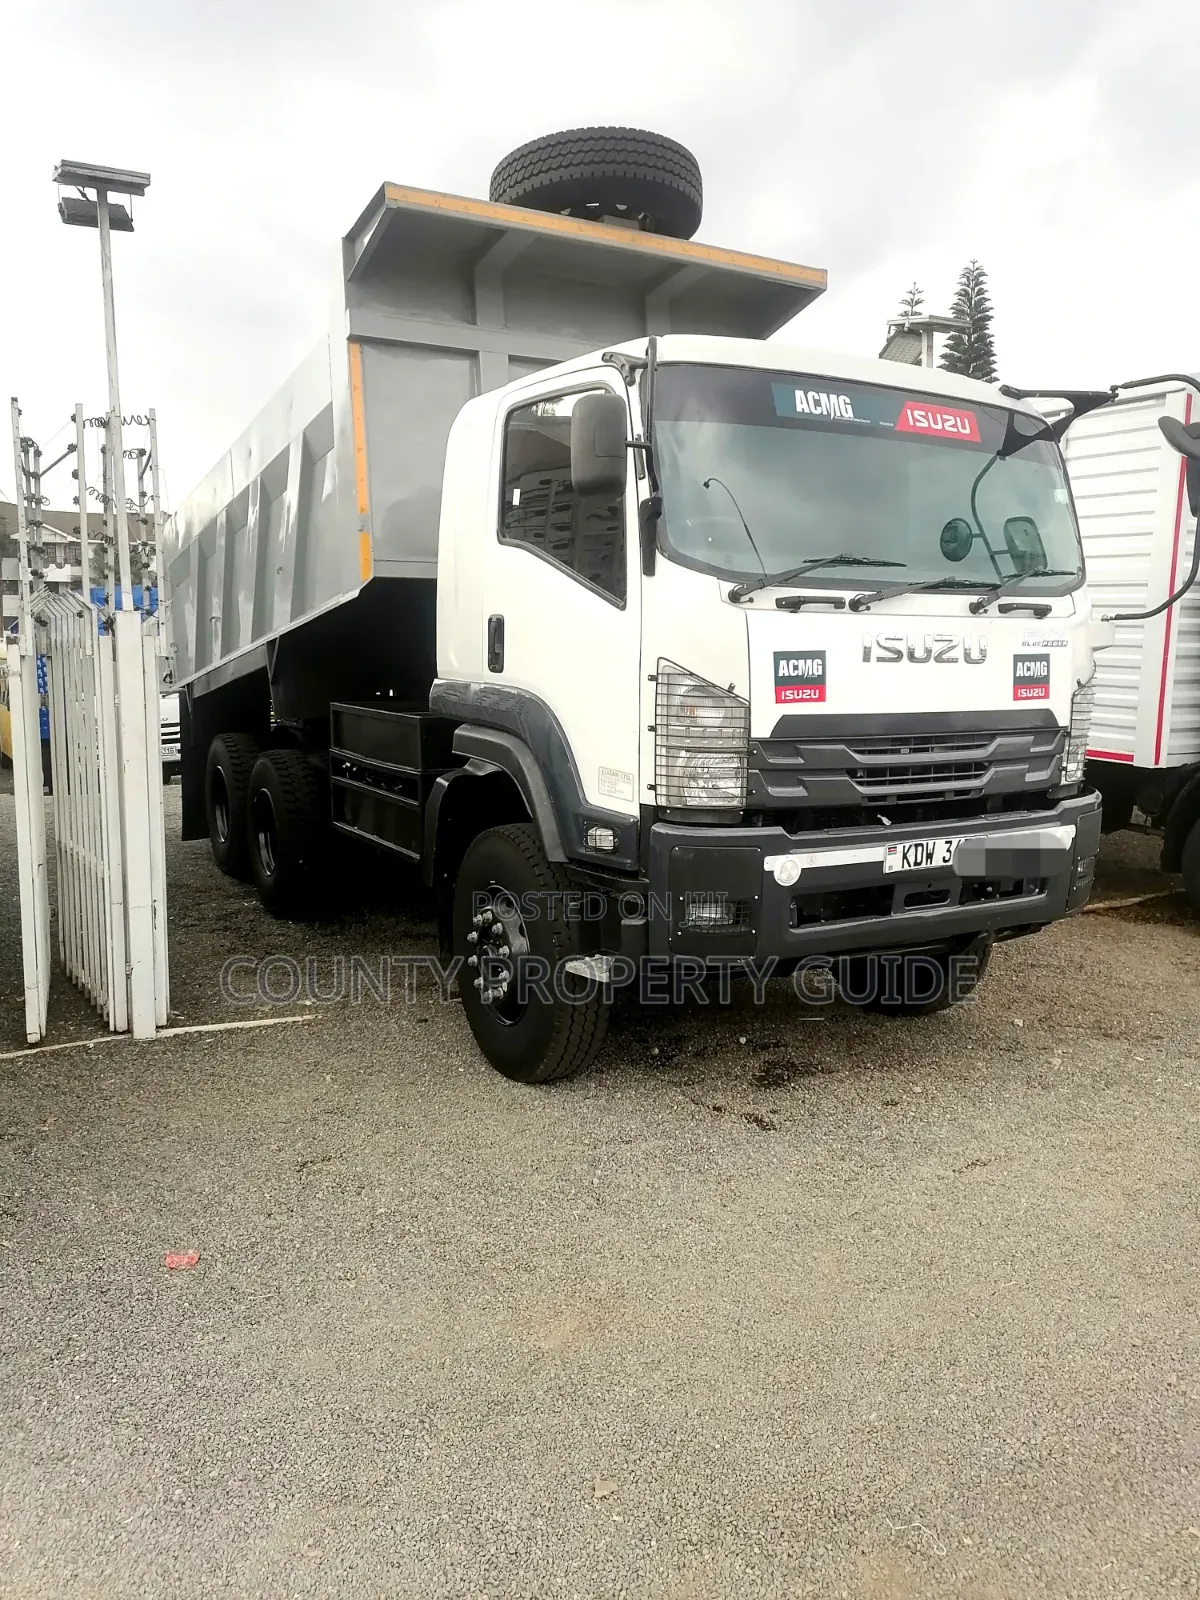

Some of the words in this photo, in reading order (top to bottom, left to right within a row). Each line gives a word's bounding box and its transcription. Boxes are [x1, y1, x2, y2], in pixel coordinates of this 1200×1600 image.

[794, 389, 854, 420] ACMG
[906, 408, 971, 435] ISUZU
[862, 631, 988, 665] ISUZU
[778, 658, 823, 679] ACMG
[1015, 660, 1048, 679] ACMG
[781, 689, 820, 701] ISUZU
[1017, 687, 1046, 698] ISUZU
[901, 841, 936, 869] KDW
